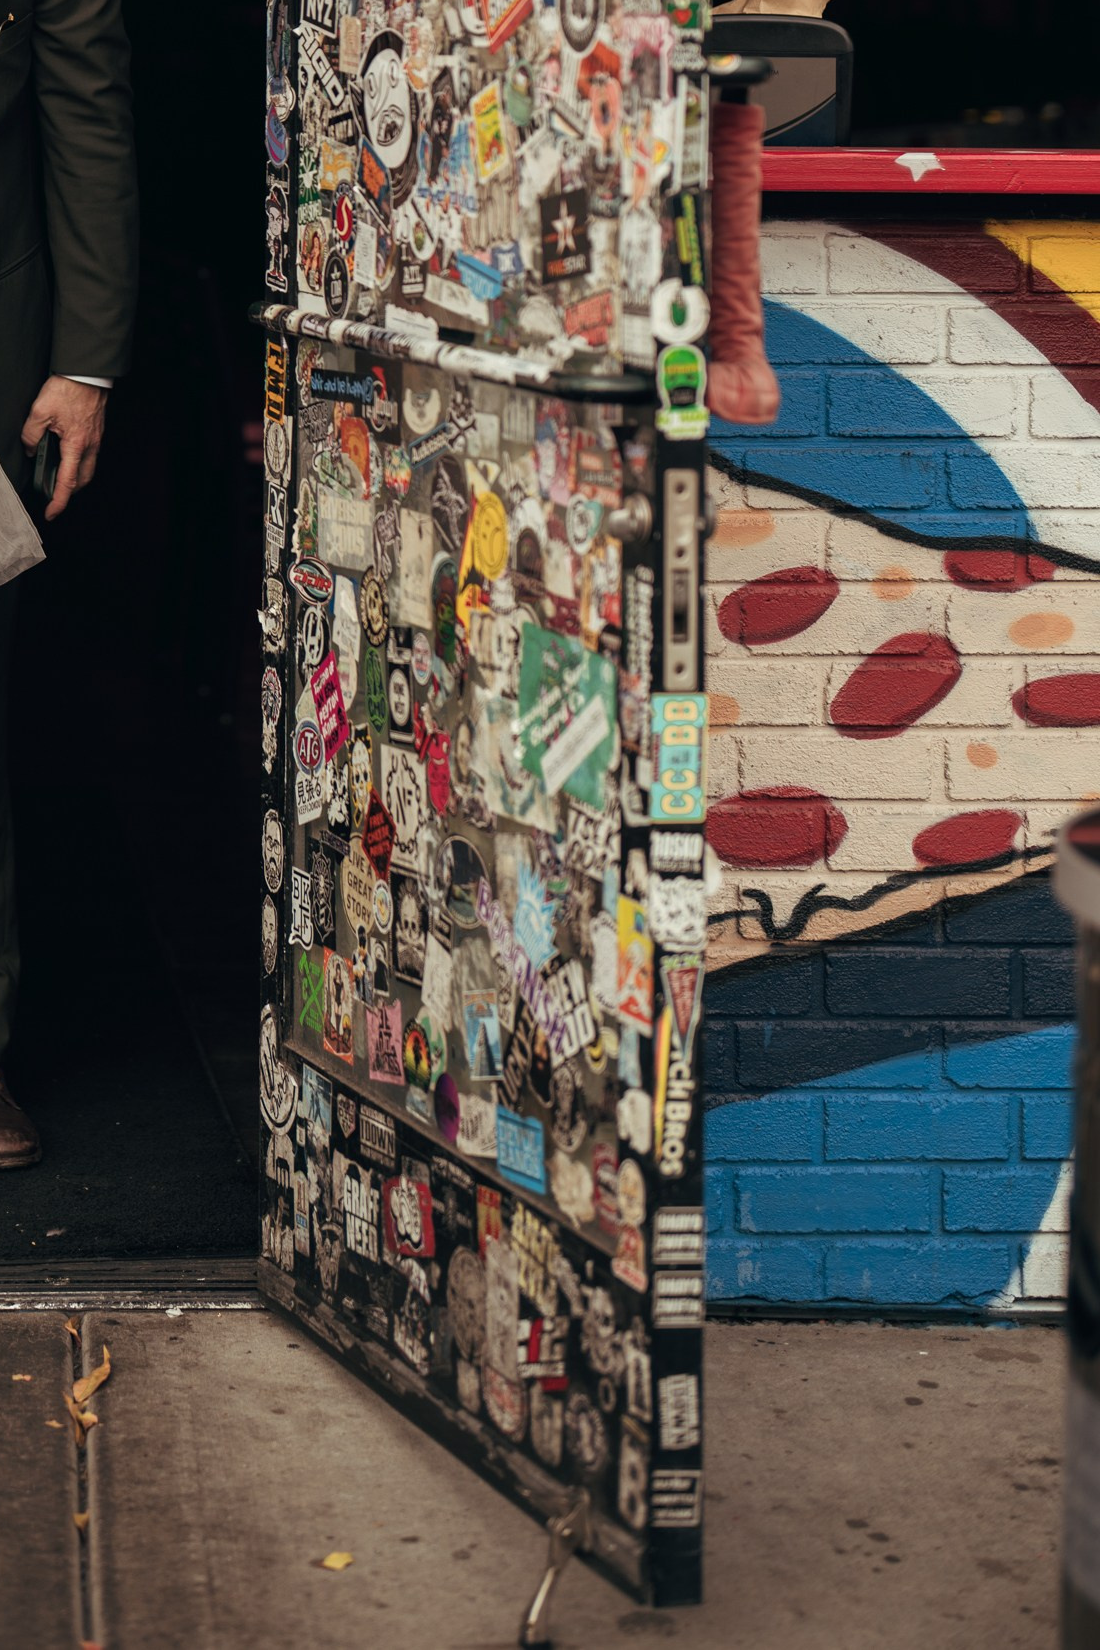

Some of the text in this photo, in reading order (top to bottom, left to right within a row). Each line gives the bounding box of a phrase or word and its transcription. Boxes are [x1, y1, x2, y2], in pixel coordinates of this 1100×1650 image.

[300, 732, 320, 764] ATG
[349, 848, 366, 871] LIVE
[347, 872, 373, 901] GREAT
[346, 897, 372, 926] STORY
[659, 1101, 692, 1178] BROS
